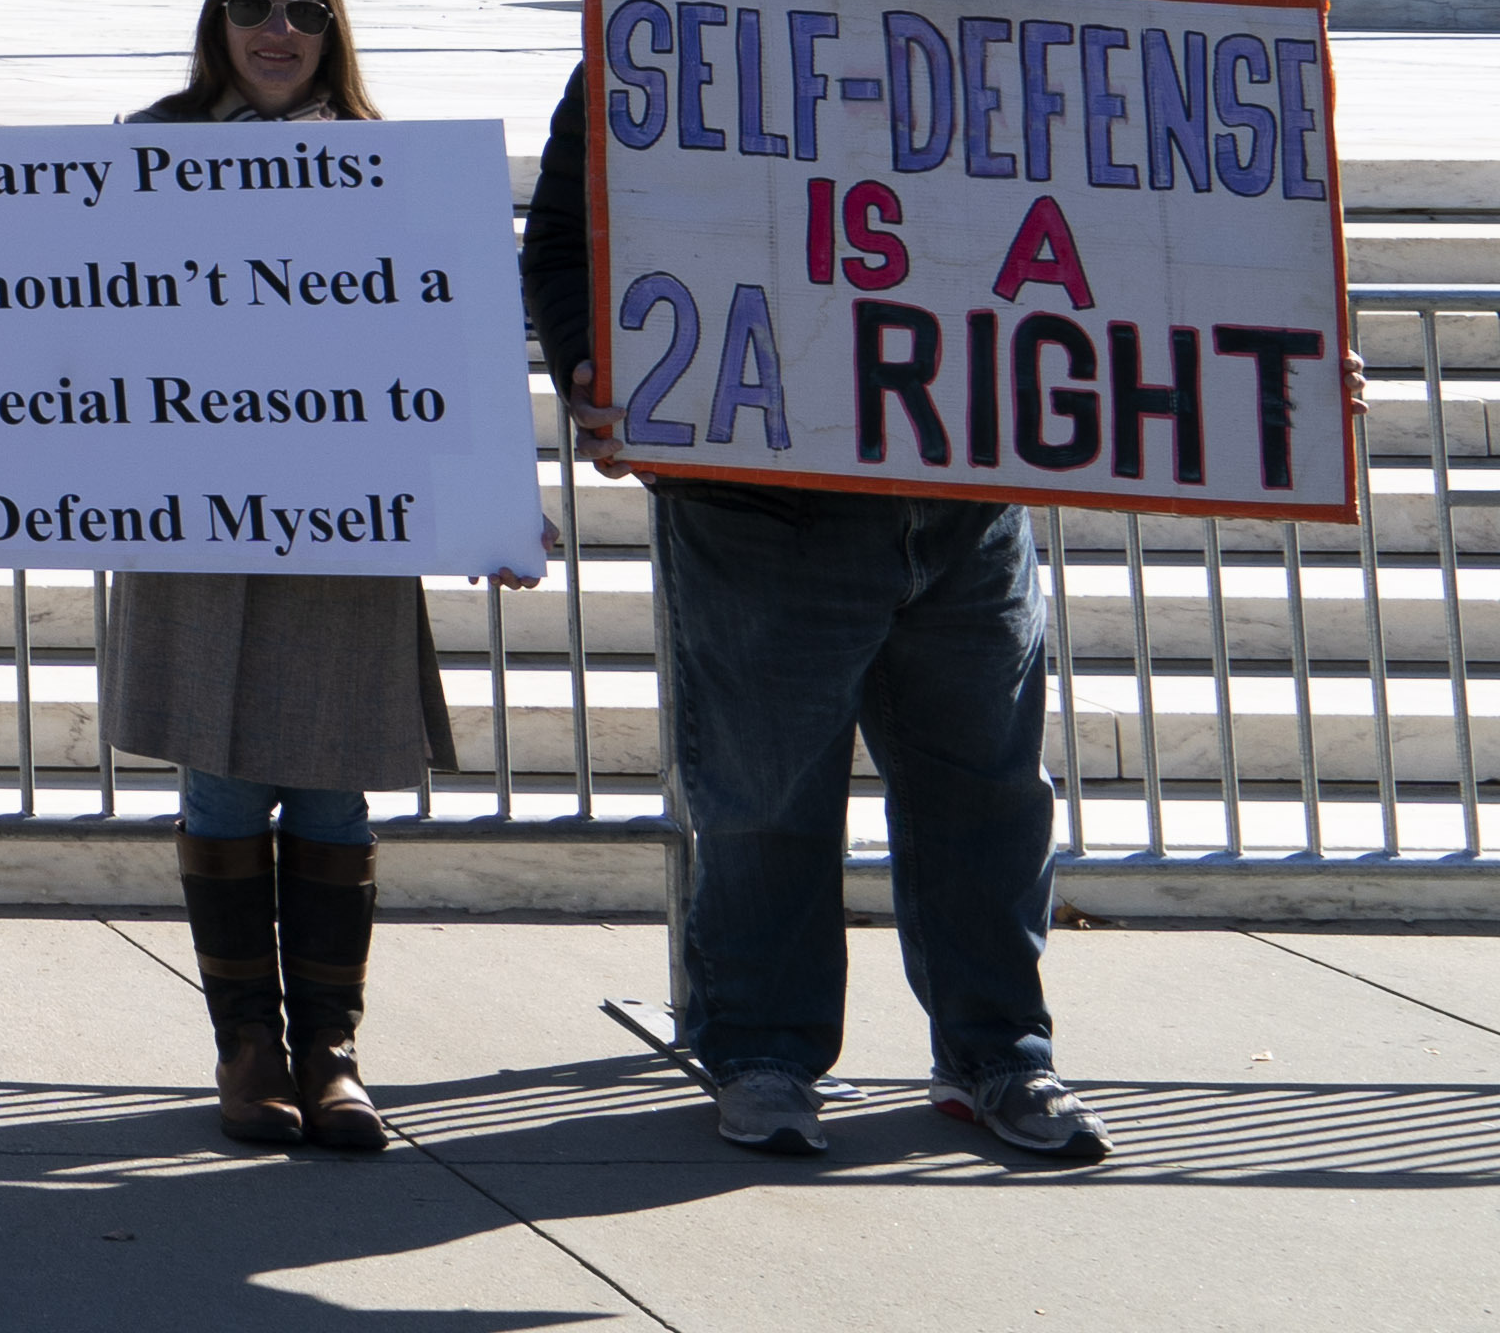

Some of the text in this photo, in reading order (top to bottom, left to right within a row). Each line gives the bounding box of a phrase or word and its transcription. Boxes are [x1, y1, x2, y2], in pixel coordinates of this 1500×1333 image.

[130, 140, 385, 194] Permits:
[806, 177, 1095, 311] IS A
[246, 255, 399, 308] Need
[420, 267, 454, 304] a
[148, 375, 368, 425] Reason
[389, 379, 446, 424] to
[619, 271, 1324, 491] 2A RIGHT
[205, 491, 416, 557] Myself
